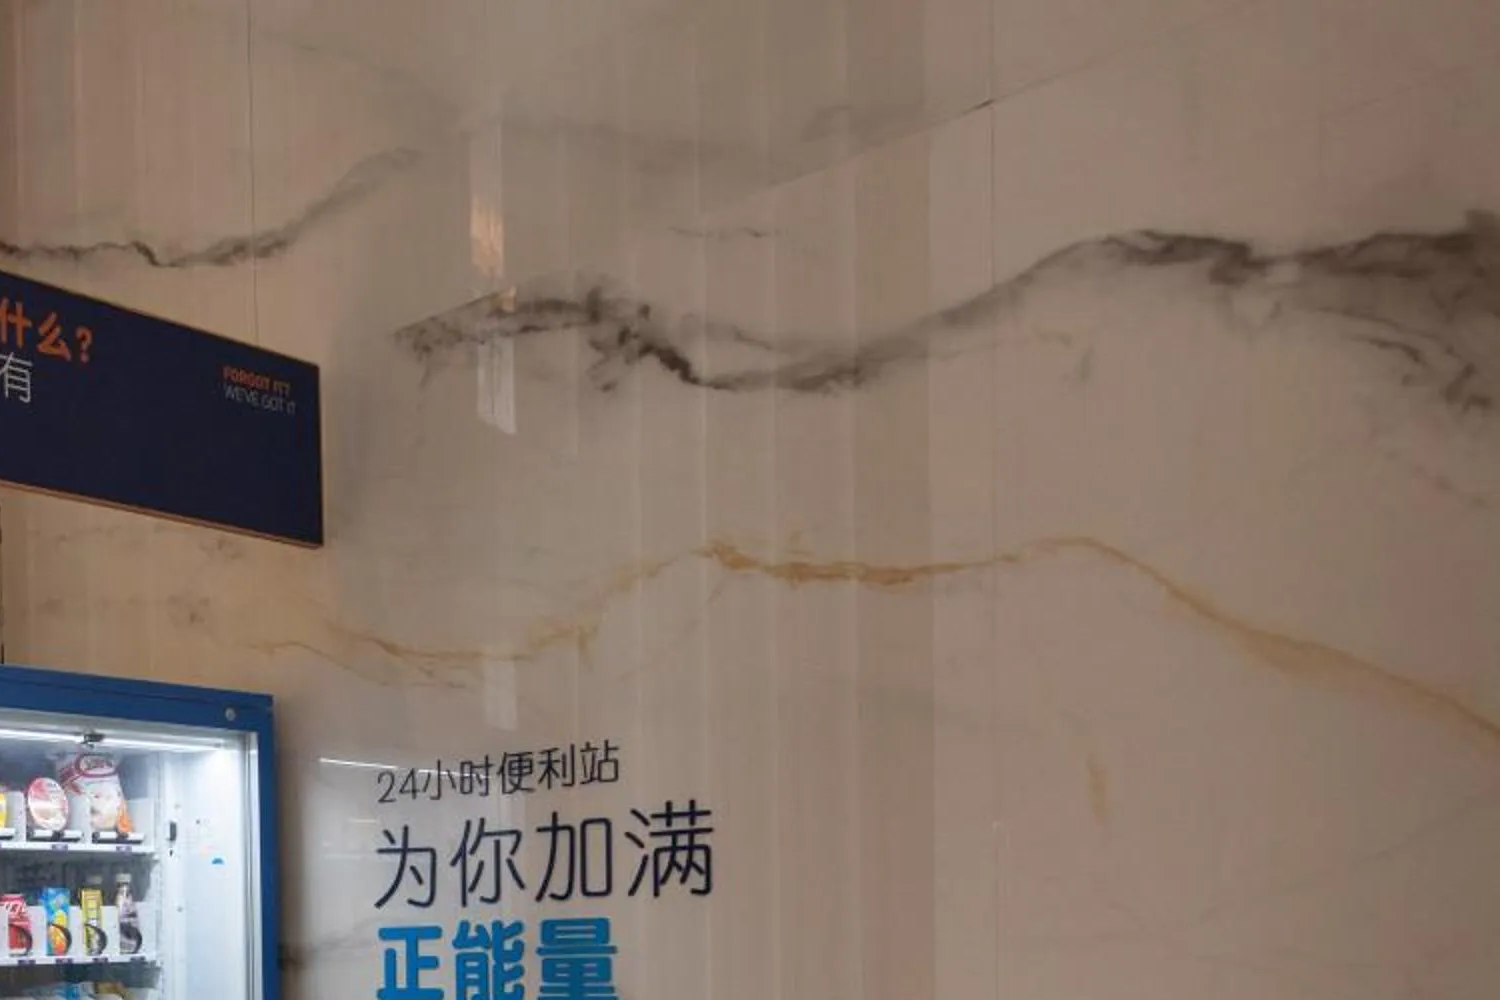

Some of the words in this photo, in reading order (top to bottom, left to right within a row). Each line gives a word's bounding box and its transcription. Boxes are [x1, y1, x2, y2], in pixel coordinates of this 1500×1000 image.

[376, 739, 620, 803] 24小时便利站
[374, 799, 714, 909] 为你加满
